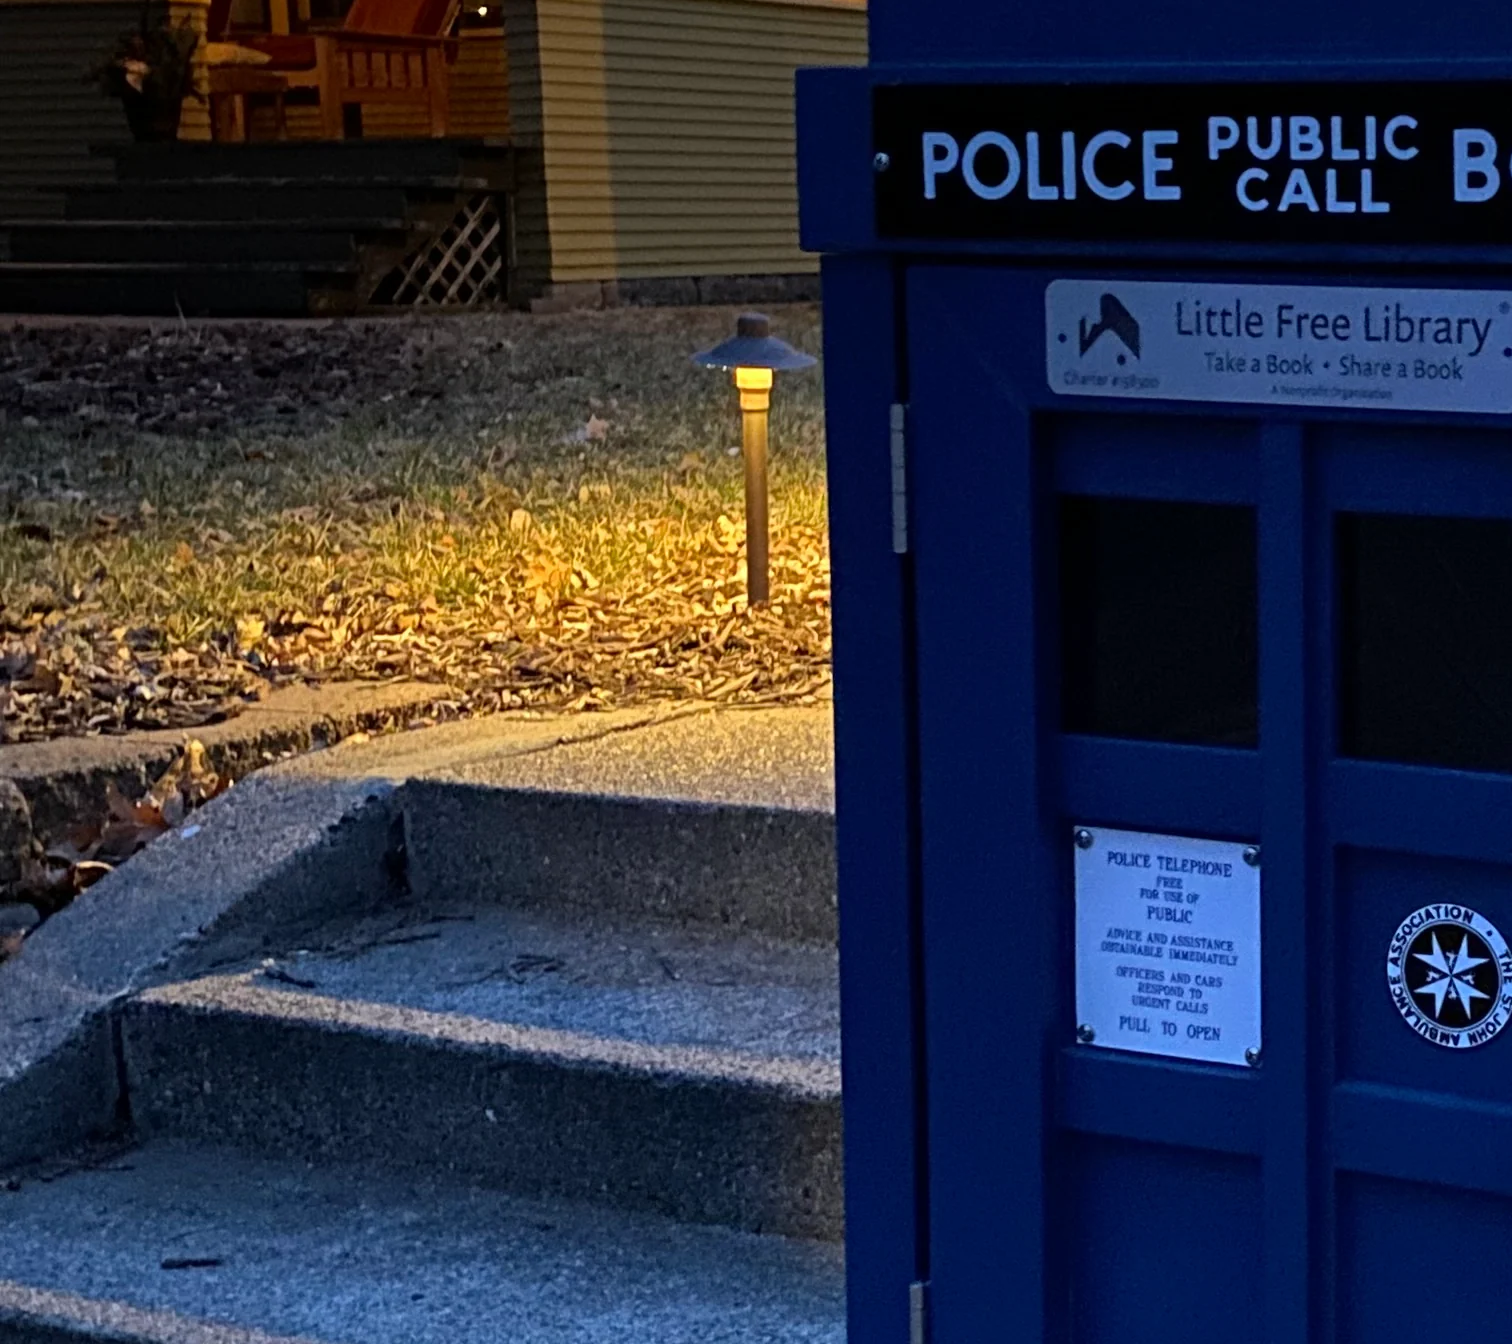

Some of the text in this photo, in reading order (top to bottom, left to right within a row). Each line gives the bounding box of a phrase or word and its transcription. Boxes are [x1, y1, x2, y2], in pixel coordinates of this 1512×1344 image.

[1208, 115, 1420, 161] PUBLIC
[922, 130, 1181, 201] POLICE
[1235, 167, 1390, 213] CALL
[1175, 298, 1493, 357] Little Free Library
[1204, 352, 1464, 381] Take a Book Share a Book
[1107, 851, 1233, 877] POLICE TELEPHONE
[1156, 876, 1183, 890] FREE
[1140, 888, 1200, 905] FOR USE OF
[1146, 905, 1193, 924] PUBLIC
[1106, 927, 1234, 952] ADVICE AND ASSISTANCE
[1388, 905, 1475, 968] ASSOCIATION
[1100, 941, 1239, 967] OBTAINABLE IMMEDIATELY
[1115, 965, 1223, 988] OFFICERS AND CARS
[1137, 982, 1203, 1000] RESPOND TO
[1131, 995, 1209, 1015] URGENT CALLS
[1389, 975, 1461, 1046] AMBULANCE
[1119, 1016, 1221, 1041] PULL TO OPEN
[1468, 1012, 1502, 1046] JOHN
